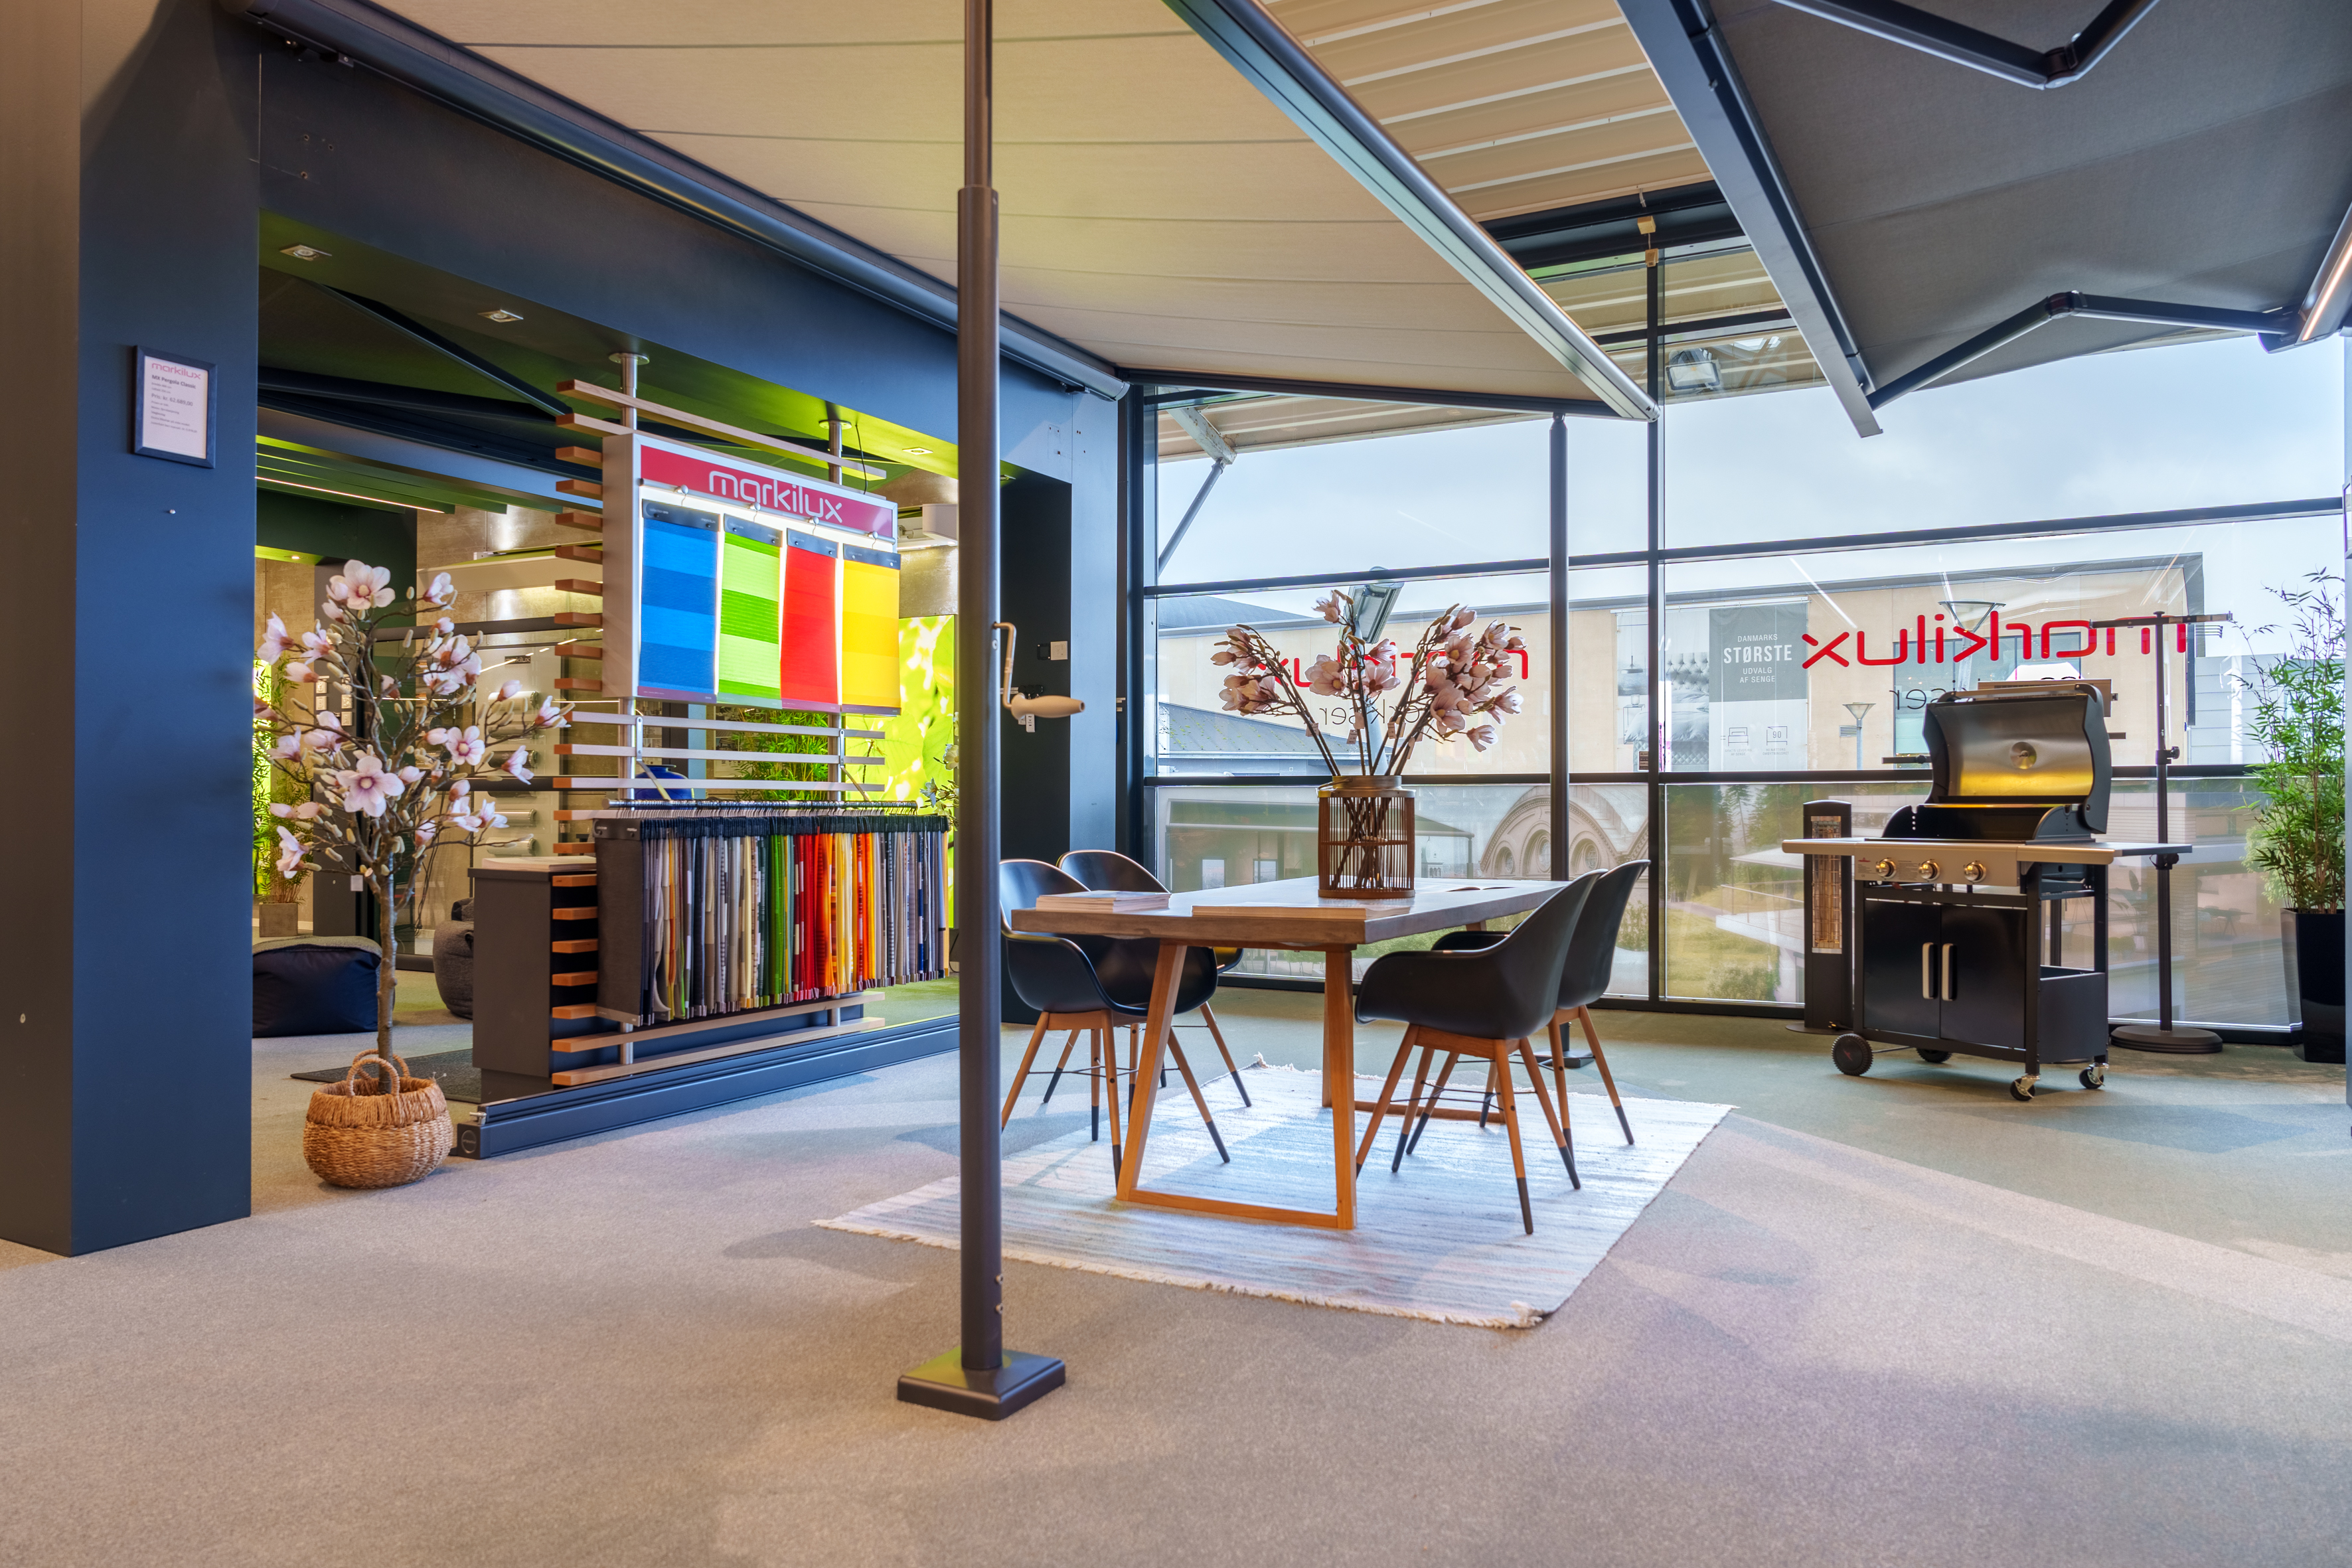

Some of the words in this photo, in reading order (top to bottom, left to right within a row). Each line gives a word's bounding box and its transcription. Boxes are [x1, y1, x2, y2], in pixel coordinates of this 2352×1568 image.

[151, 363, 201, 380] markilux
[161, 376, 179, 385] Pergola
[708, 470, 843, 524] markilux
[1737, 633, 1778, 643] DANMARKS
[1723, 644, 1792, 664] STØRSTE
